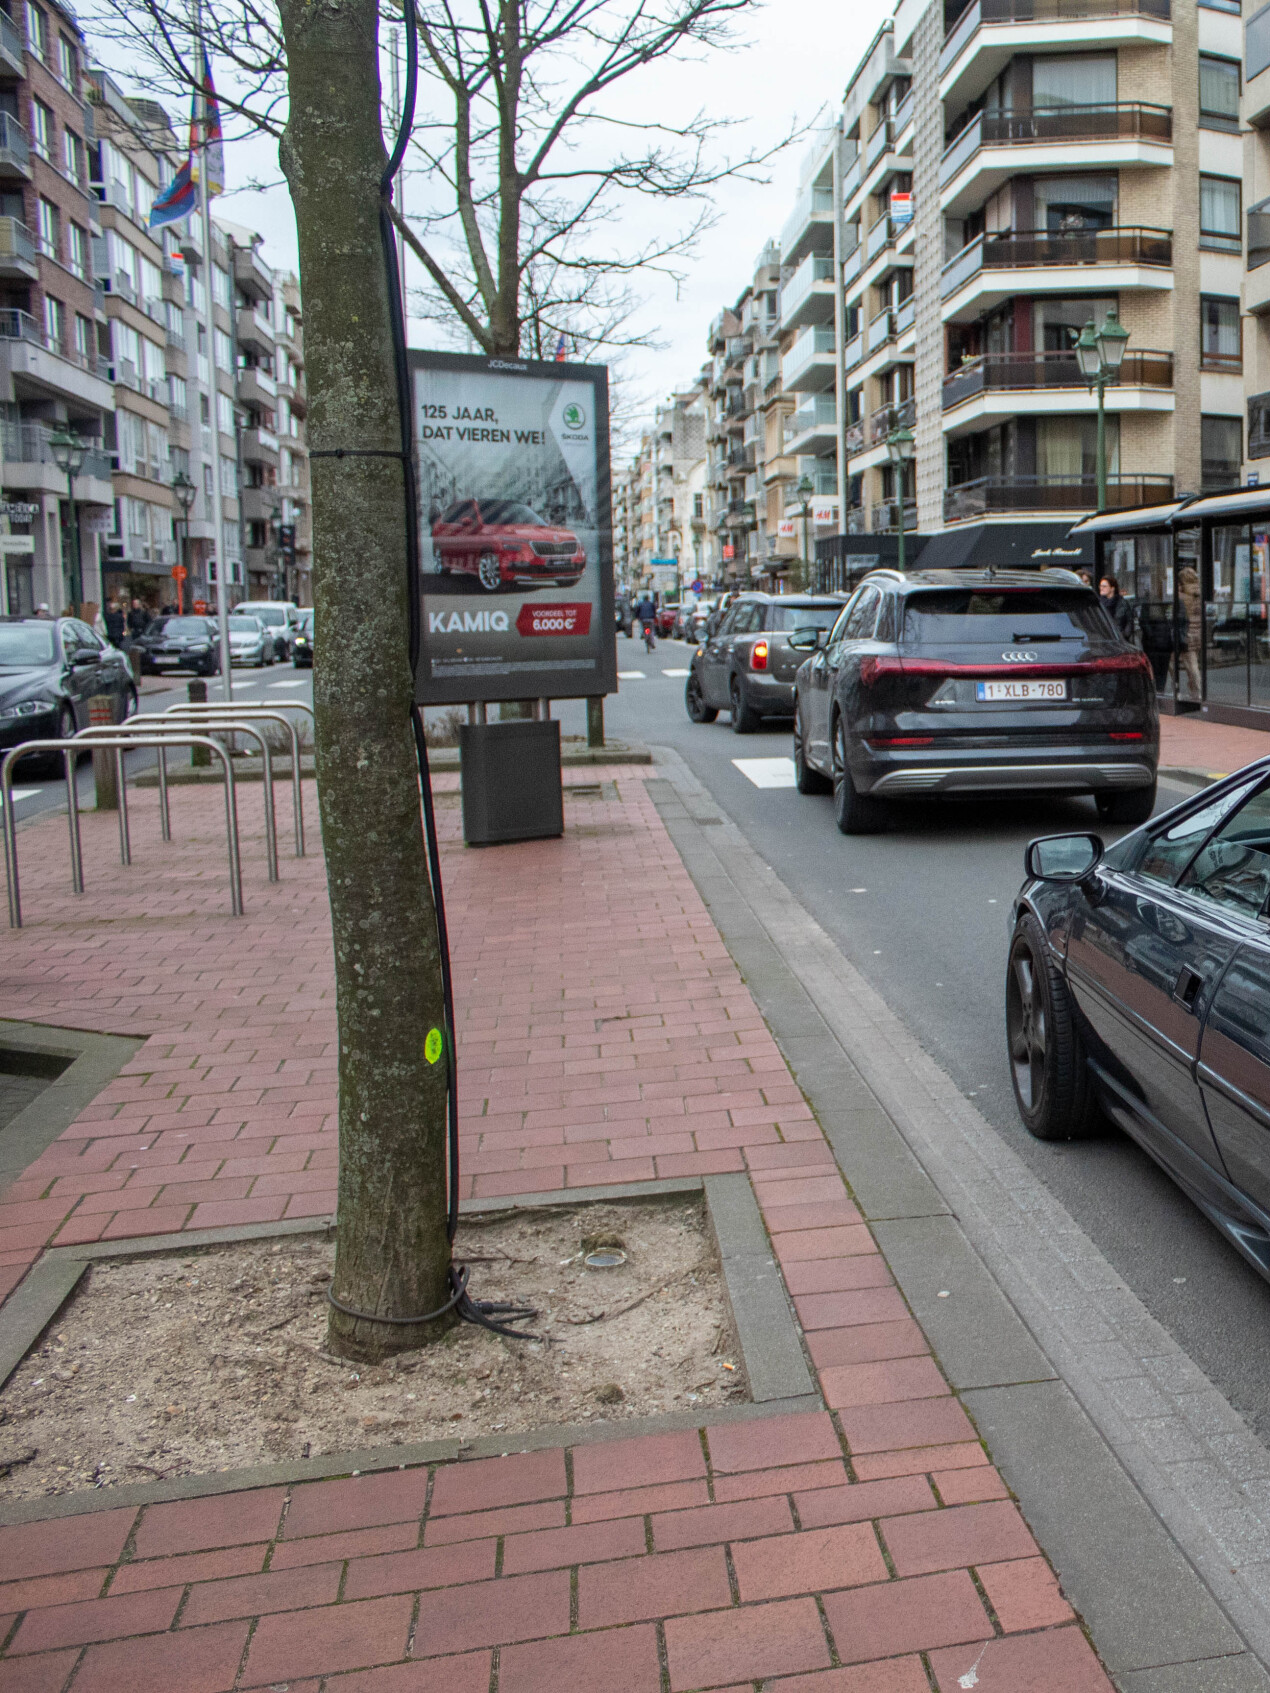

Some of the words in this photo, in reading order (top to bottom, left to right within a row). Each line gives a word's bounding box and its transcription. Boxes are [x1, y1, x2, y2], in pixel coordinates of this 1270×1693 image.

[487, 360, 528, 371] JCDecaux
[421, 405, 447, 419] 125
[452, 406, 499, 425] JAAR,
[422, 425, 454, 440] DAT
[456, 427, 511, 443] VIEREN
[514, 430, 546, 445] WE!
[428, 610, 510, 633] KAMIQ
[565, 609, 577, 617] TOT
